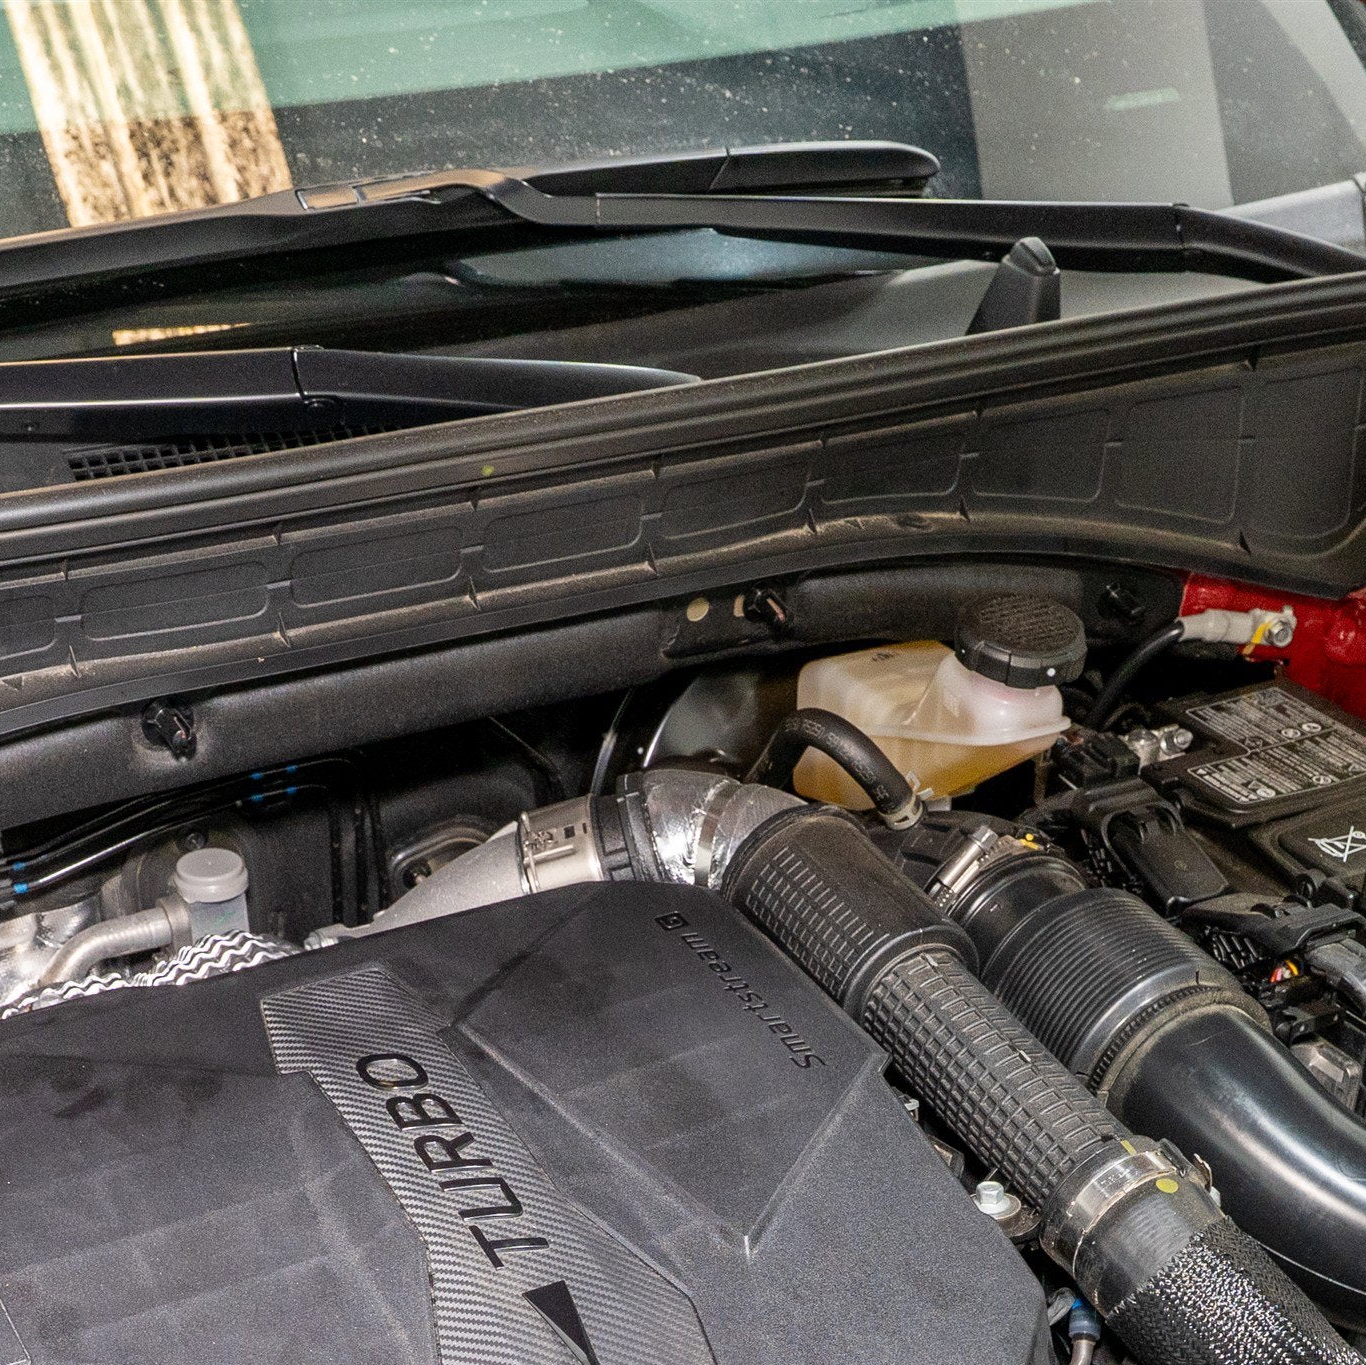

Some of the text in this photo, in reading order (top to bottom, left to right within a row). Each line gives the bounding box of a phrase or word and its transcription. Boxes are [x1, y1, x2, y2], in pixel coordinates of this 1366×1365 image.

[653, 910, 827, 1069] Smartstream G
[355, 1052, 551, 1270] TURBO
